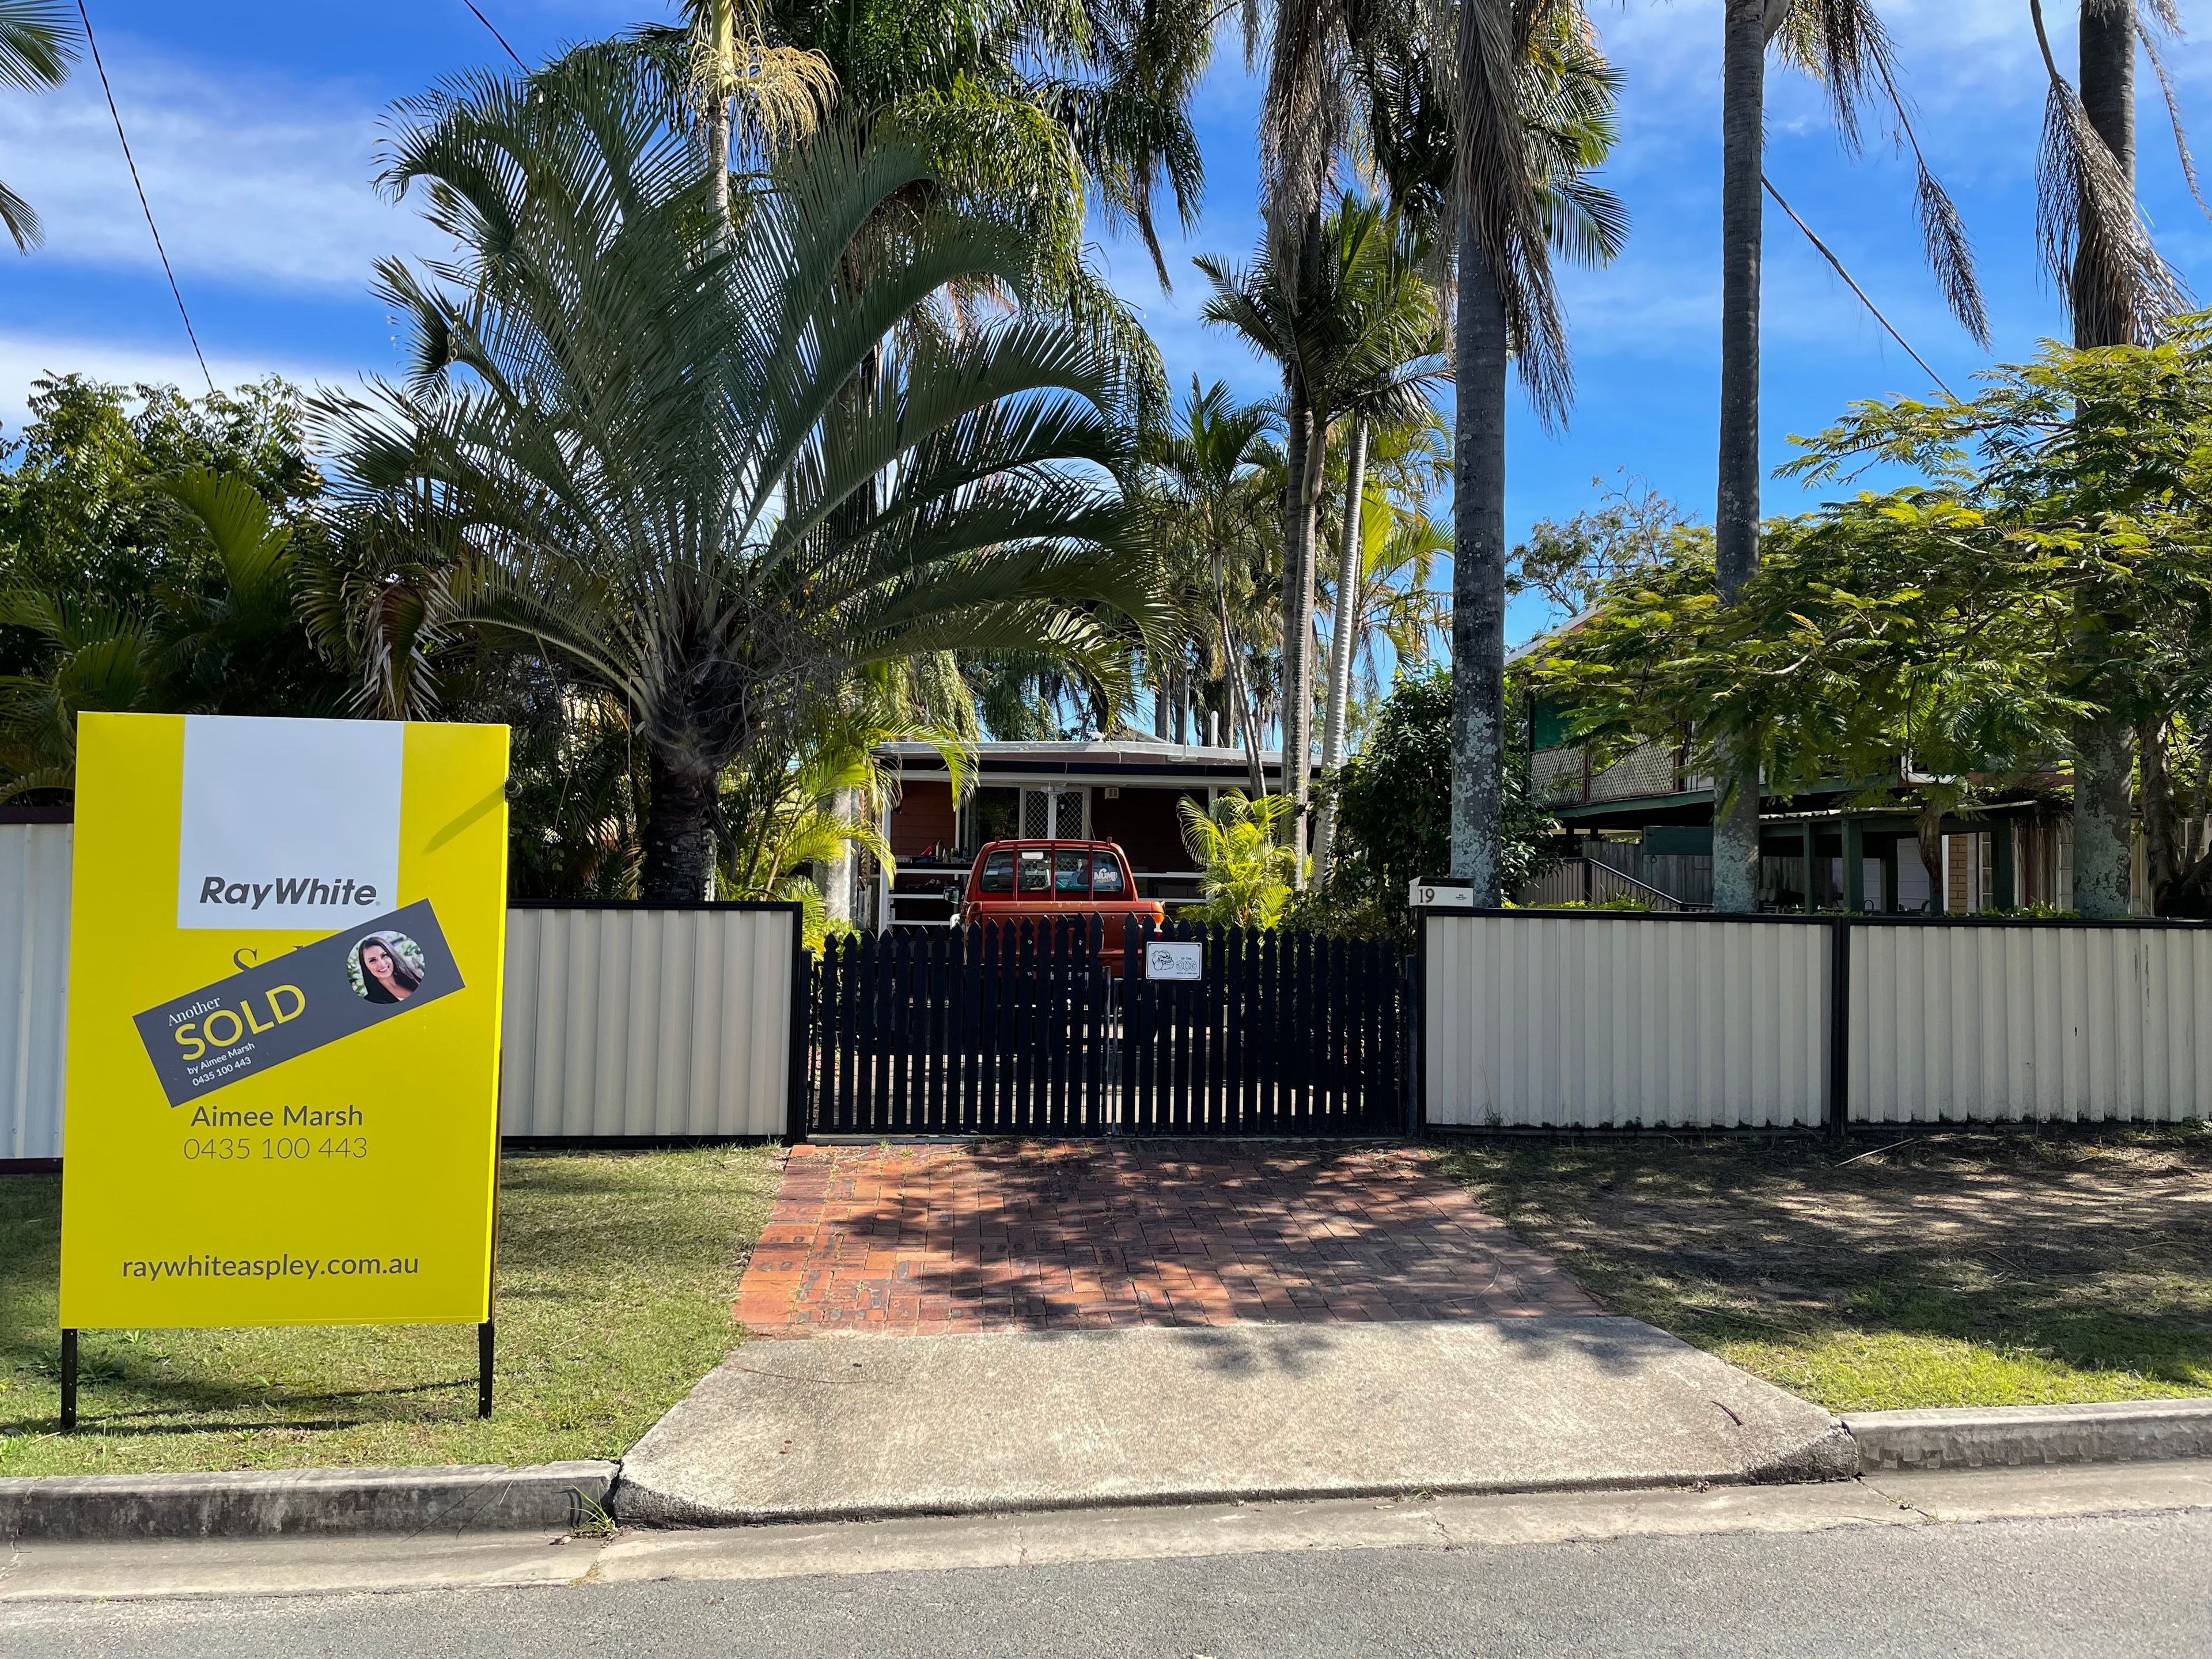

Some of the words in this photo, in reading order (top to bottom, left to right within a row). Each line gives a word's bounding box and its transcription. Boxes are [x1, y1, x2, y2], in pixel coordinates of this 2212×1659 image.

[1419, 888, 1435, 903] 19
[1176, 960, 1197, 971] DOG
[168, 997, 221, 1027] Another
[175, 984, 306, 1060] SOLD
[187, 1066, 198, 1075] by
[200, 1054, 227, 1070] Aimee
[228, 1042, 255, 1058] Marsh
[192, 1071, 215, 1086] 0435
[216, 1064, 233, 1077] 100
[234, 1056, 252, 1069] 443
[191, 1105, 274, 1127] Aimee
[283, 1104, 363, 1127] Marsh
[184, 1138, 250, 1160] 0435
[262, 1138, 310, 1159] 100
[318, 1137, 368, 1158] 443
[123, 1253, 419, 1282] raywhiteaspley.com.au
